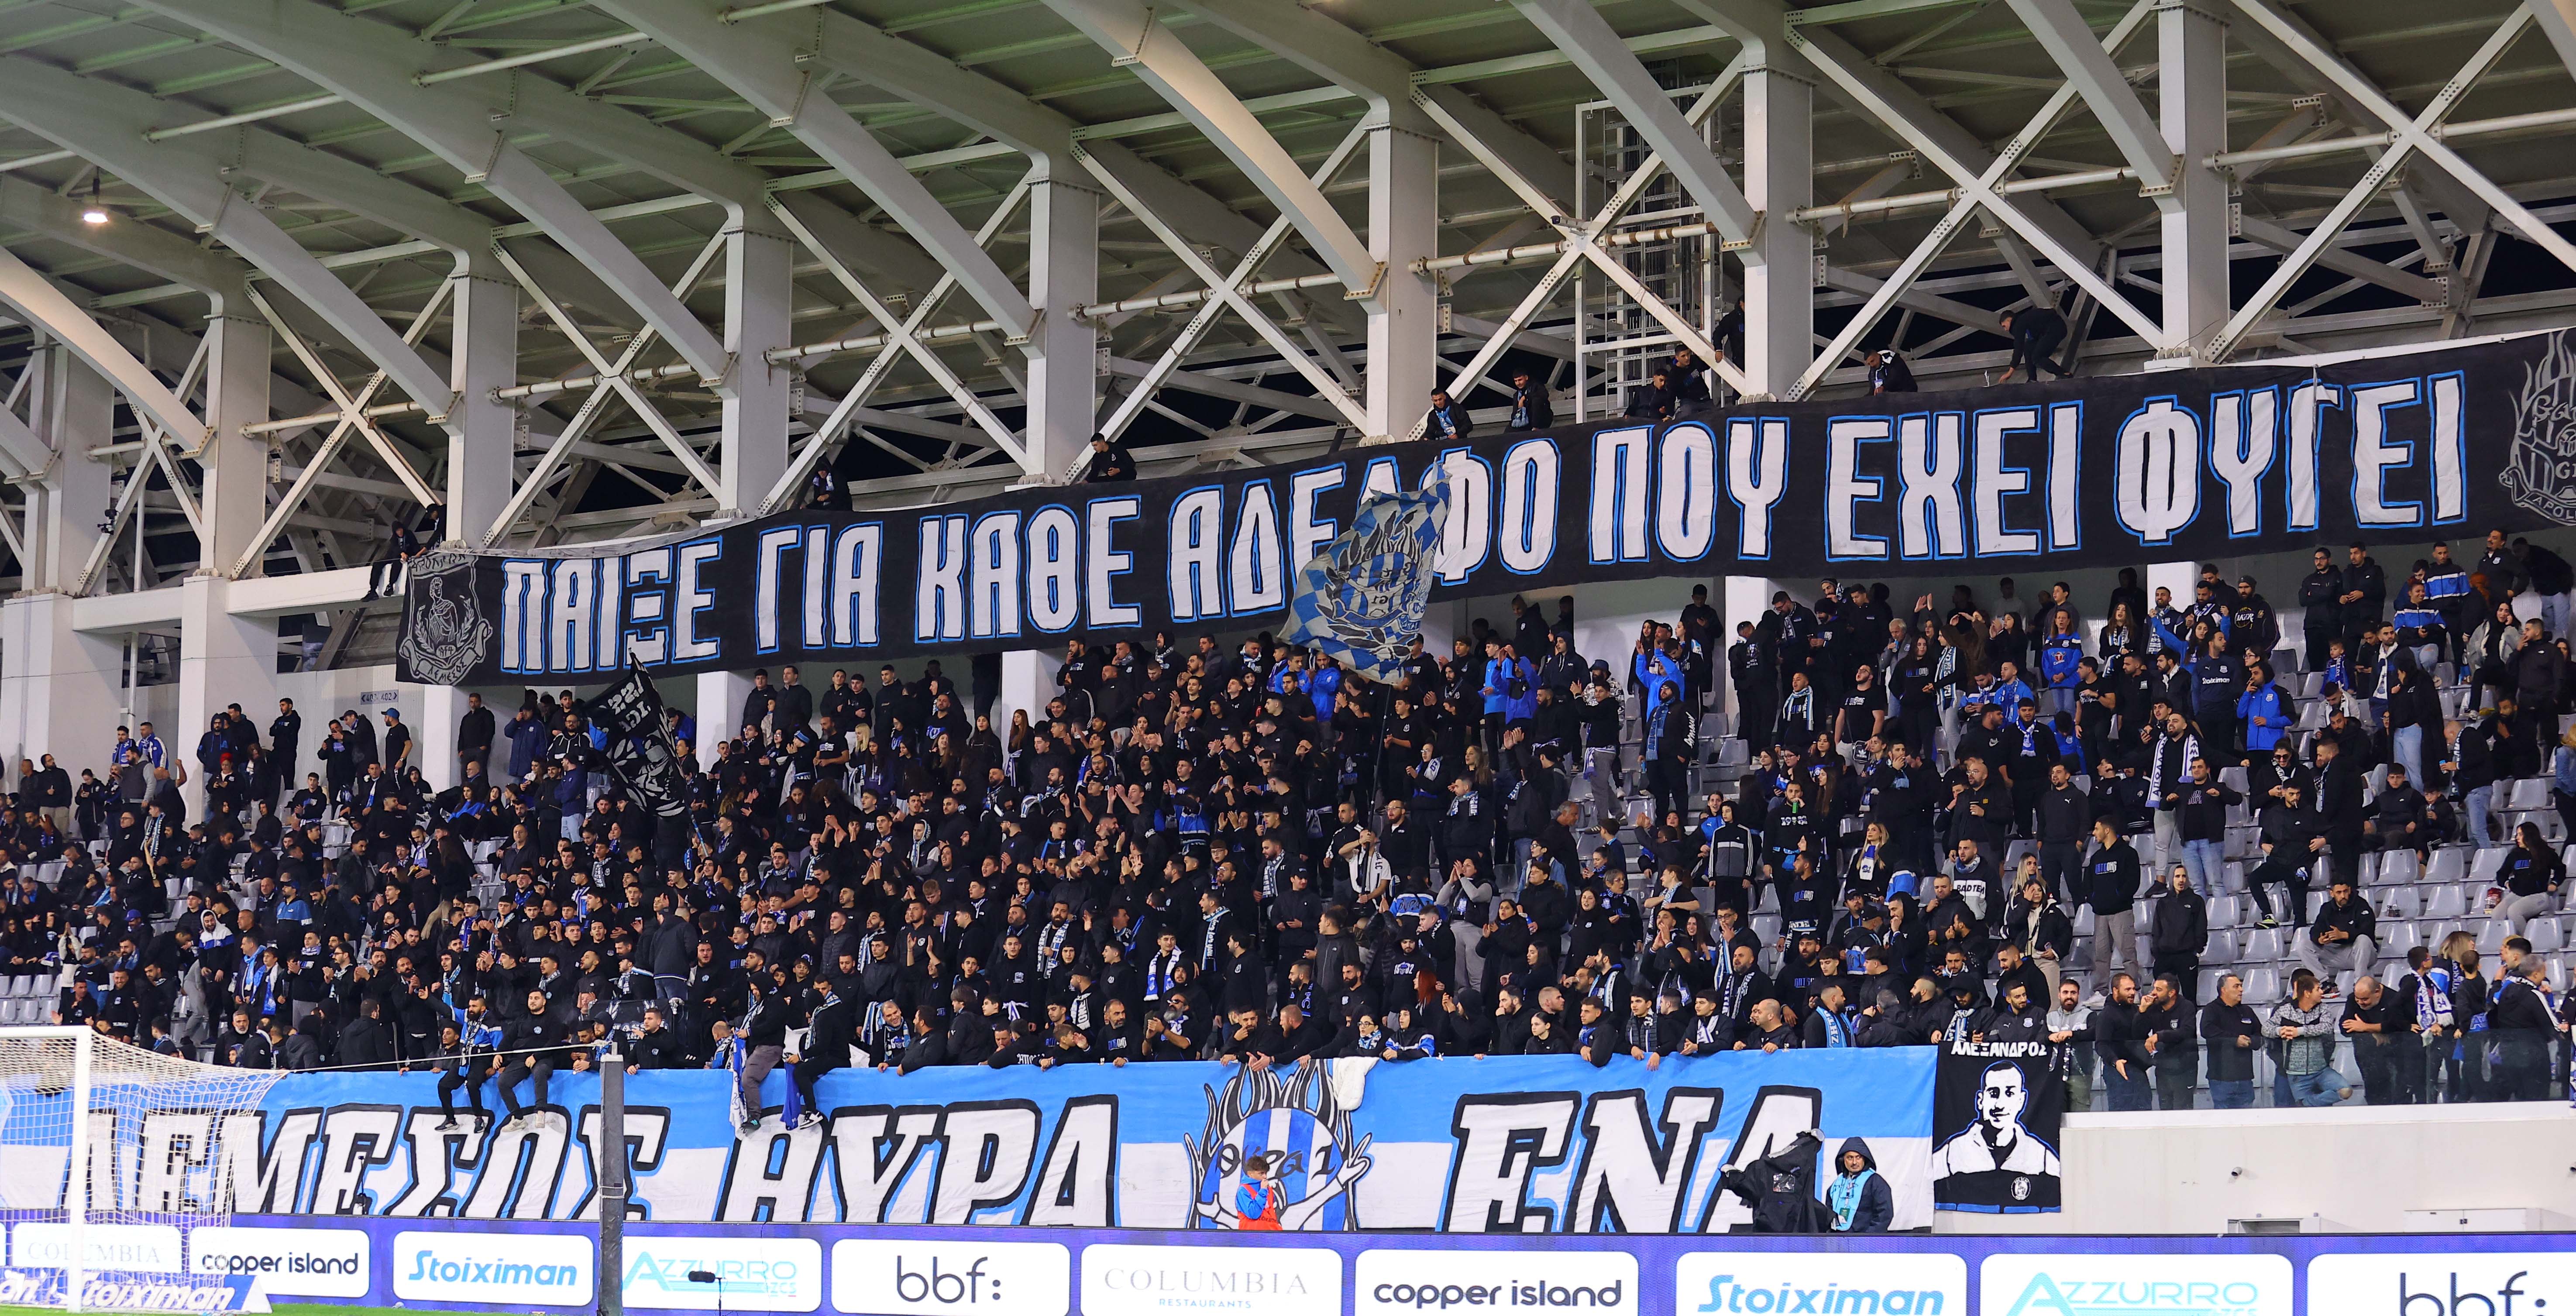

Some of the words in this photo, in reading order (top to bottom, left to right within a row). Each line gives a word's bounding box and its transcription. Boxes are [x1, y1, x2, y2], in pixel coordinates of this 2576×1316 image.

[501, 536, 722, 673] ΠΑΙΞΕ
[757, 521, 883, 653] ΓΙΑ
[915, 495, 1143, 643] ΚΑΘΕ
[1589, 416, 1791, 565] ΠΟΥ
[1824, 400, 2084, 562] ΕΧΕΙ
[2114, 370, 2466, 546] ΦΥΓΕΙ
[1951, 1041, 2047, 1057] ΑΛΕΞΑΝΔΡΟΣ
[1443, 1086, 1822, 1234] ΕΝΑ
[202, 1253, 282, 1274] copper
[288, 1251, 358, 1275] island
[408, 1250, 578, 1286] Stoiximan
[622, 1251, 797, 1292] AZZURRO
[896, 1255, 1002, 1304] bbf:
[1104, 1268, 1308, 1295] COLUMBIA
[1159, 1298, 1251, 1309] RESTAURANTS
[1374, 1283, 1502, 1310] copper
[1511, 1279, 1621, 1307] island
[1697, 1274, 1945, 1316] Stoiximan
[2006, 1272, 2259, 1316] AZZURRO
